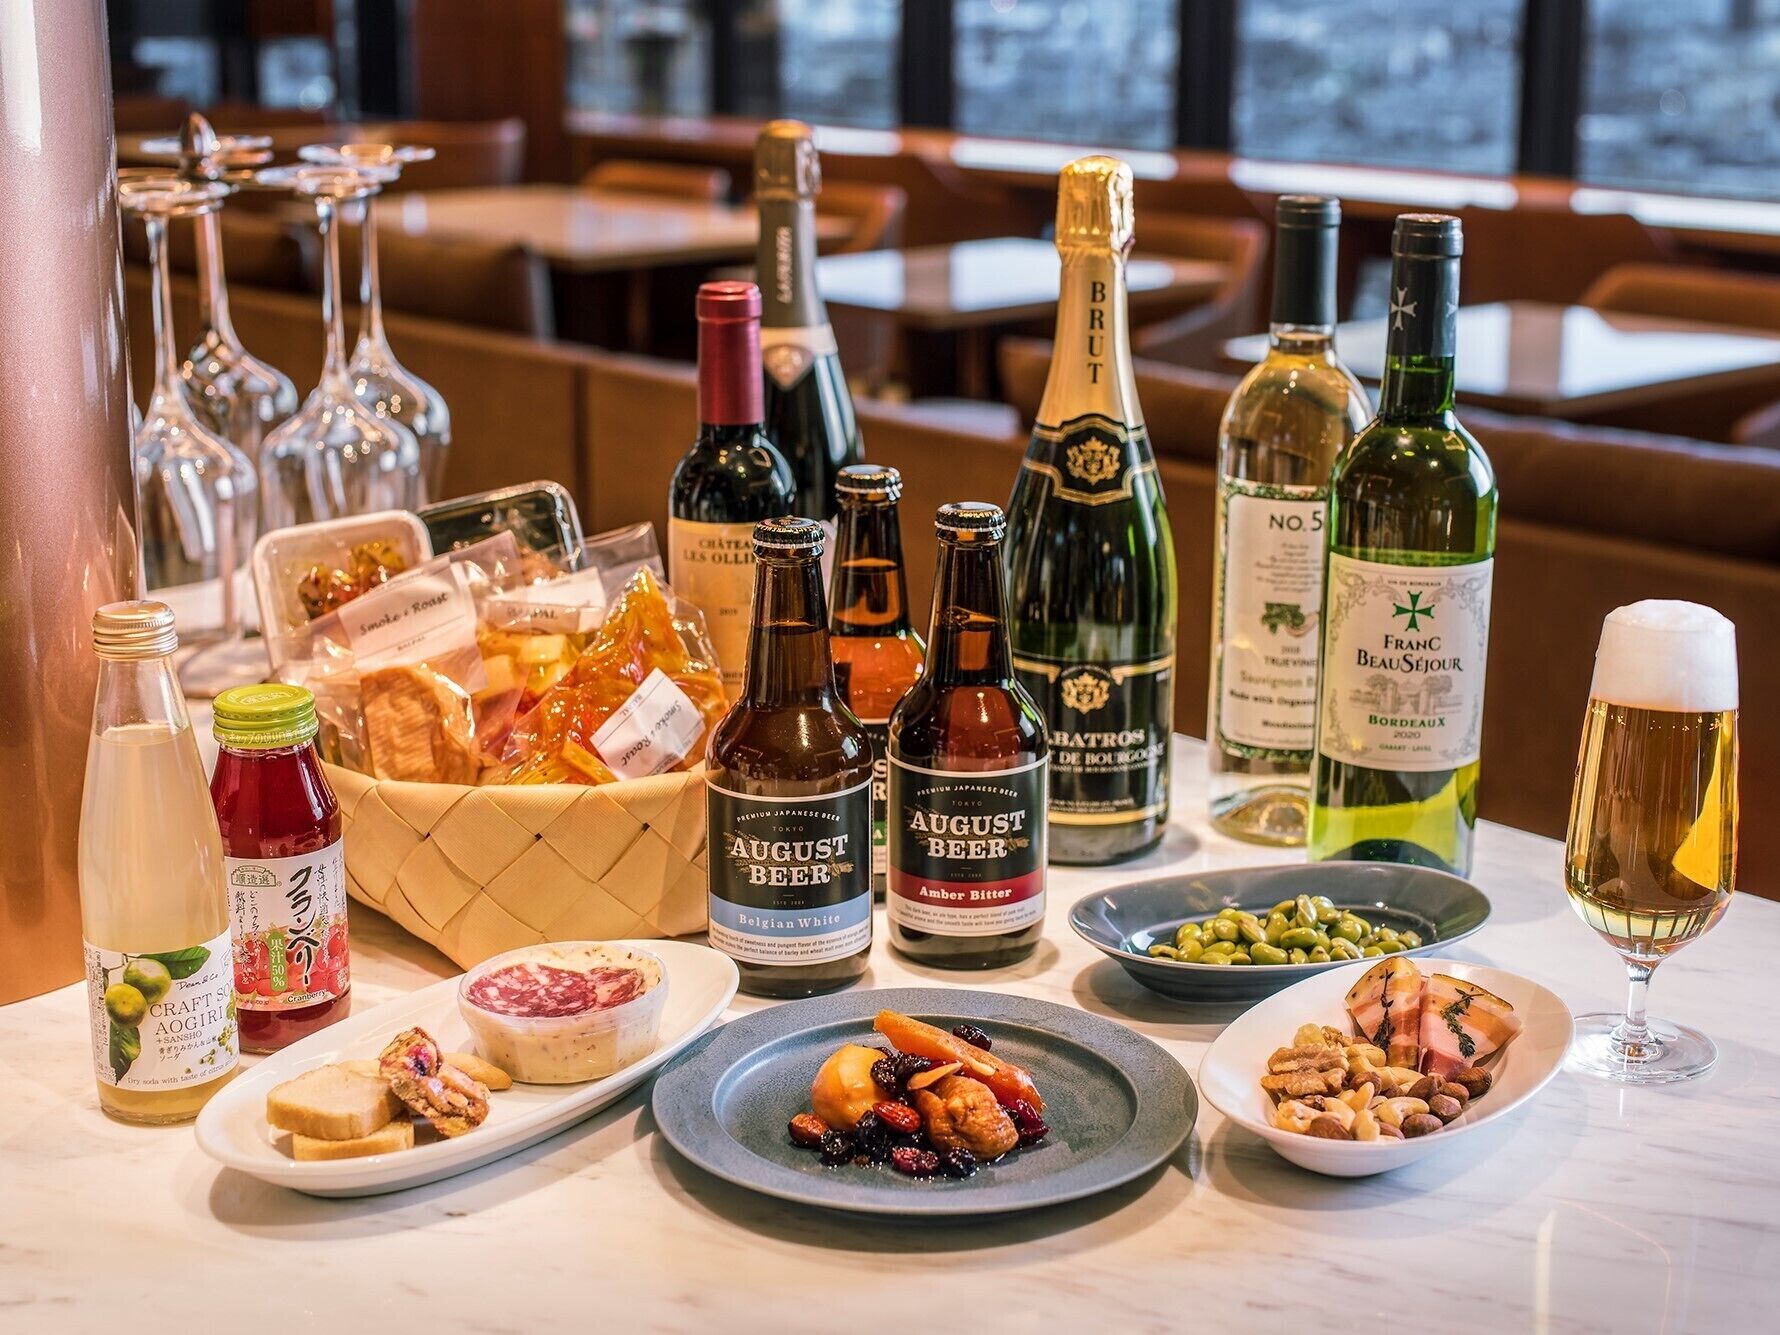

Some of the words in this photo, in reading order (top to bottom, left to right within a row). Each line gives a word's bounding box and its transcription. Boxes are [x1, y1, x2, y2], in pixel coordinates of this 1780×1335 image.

[1089, 281, 1105, 384] BRUT
[360, 613, 402, 636] Smoke
[411, 592, 448, 614] Roast
[655, 700, 682, 730] Smoke
[1368, 714, 1446, 727] BORDEAUX
[1394, 730, 1421, 739] 2020
[621, 736, 651, 766] Roast
[1060, 751, 1081, 765] DE
[916, 786, 950, 796] PREMIUM
[954, 785, 997, 794] JAPANESE
[1000, 788, 1018, 798] BEER
[736, 810, 771, 823] PREMIUM
[774, 809, 818, 818] JAPANESE
[821, 812, 841, 822] BEER
[910, 810, 1025, 836] AUGUST
[730, 834, 849, 862] AUGUST
[927, 838, 1008, 859] BEER
[749, 864, 831, 887] BEER
[919, 886, 965, 901] Amber
[970, 886, 1012, 901] Bitter
[286, 865, 320, 985] クランベリー
[739, 914, 794, 930] Belgian
[798, 914, 841, 928] White
[271, 938, 285, 987] 果汁50%
[149, 992, 213, 1017] CRAFT
[287, 990, 326, 1003] Cranberry
[155, 1006, 223, 1035] AOGIRI
[159, 1052, 181, 1061] ソーダ
[127, 1076, 140, 1085] Dry
[161, 1074, 178, 1083] with
[181, 1073, 198, 1082] taste
[200, 1069, 208, 1077] of
